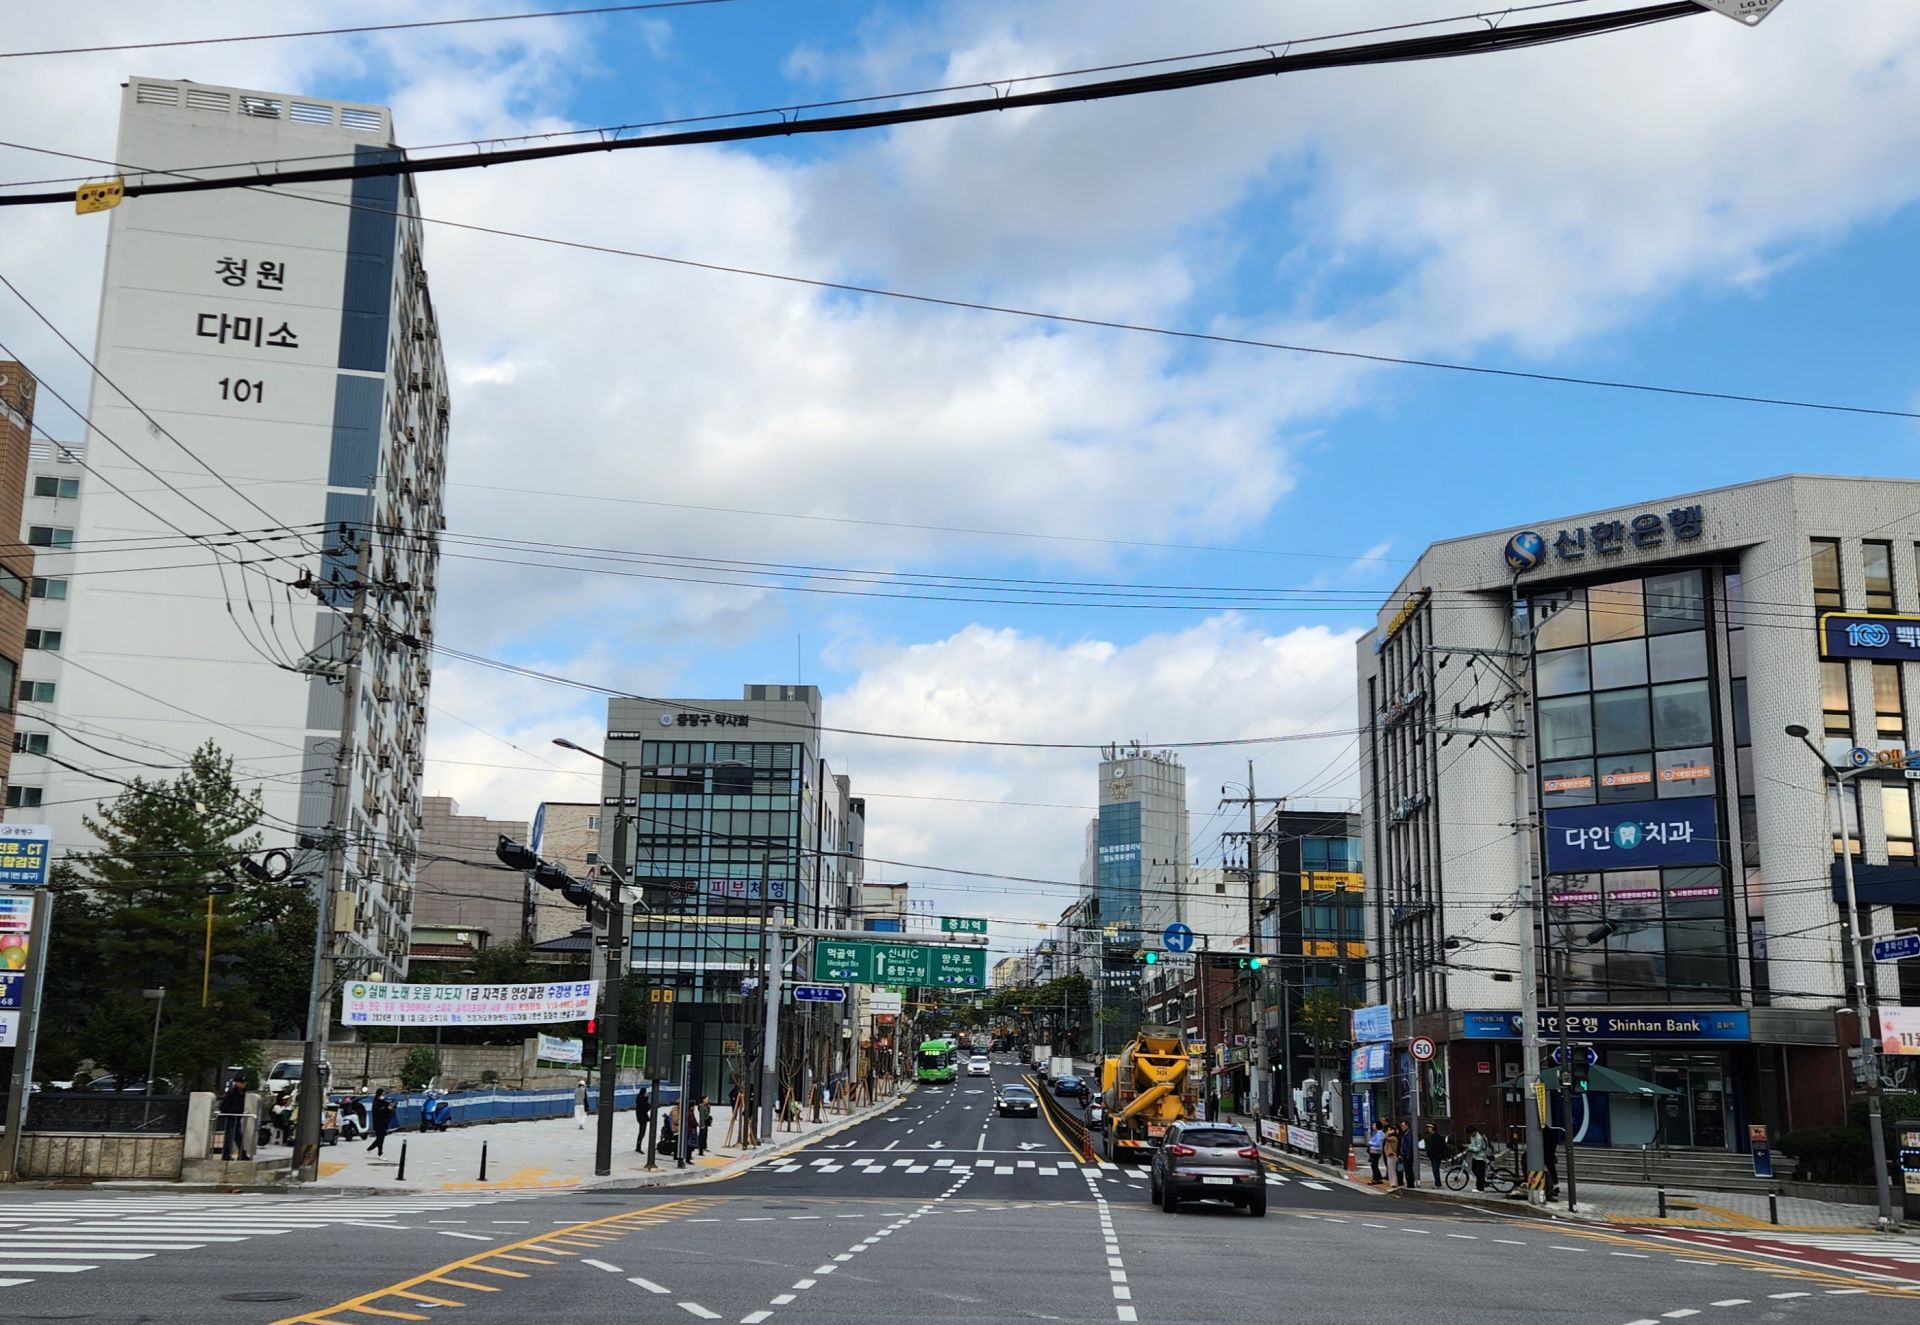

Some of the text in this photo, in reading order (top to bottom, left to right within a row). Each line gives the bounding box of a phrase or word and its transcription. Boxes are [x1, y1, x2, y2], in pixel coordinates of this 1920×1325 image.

[215, 256, 285, 291] 청원
[196, 312, 300, 349] 다미소
[217, 377, 264, 404] 101
[1553, 504, 1704, 560] 신한은행
[1565, 820, 1694, 850] 다인 치과
[27, 843, 44, 855] CT
[0, 856, 41, 869] 합검진
[948, 919, 981, 931] 중화역
[827, 948, 856, 960] 먹골역
[888, 948, 919, 960] 신내IC
[942, 953, 972, 965] 망우로
[887, 965, 925, 977] 중랑구청
[941, 965, 973, 973] Mangu-ro
[369, 984, 388, 999] 실버
[391, 985, 410, 999] 노래
[413, 986, 432, 1000] 웃음
[434, 987, 462, 1000] 지도자
[465, 987, 479, 1001] 1급
[482, 987, 509, 1001] 자격증
[547, 984, 572, 999] 수강생
[575, 983, 591, 997] 모집
[1608, 1018, 1662, 1031] Shinhan
[1666, 1019, 1700, 1031] Bank
[1415, 1043, 1431, 1055] 50
[1580, 1080, 1588, 1091] 4
